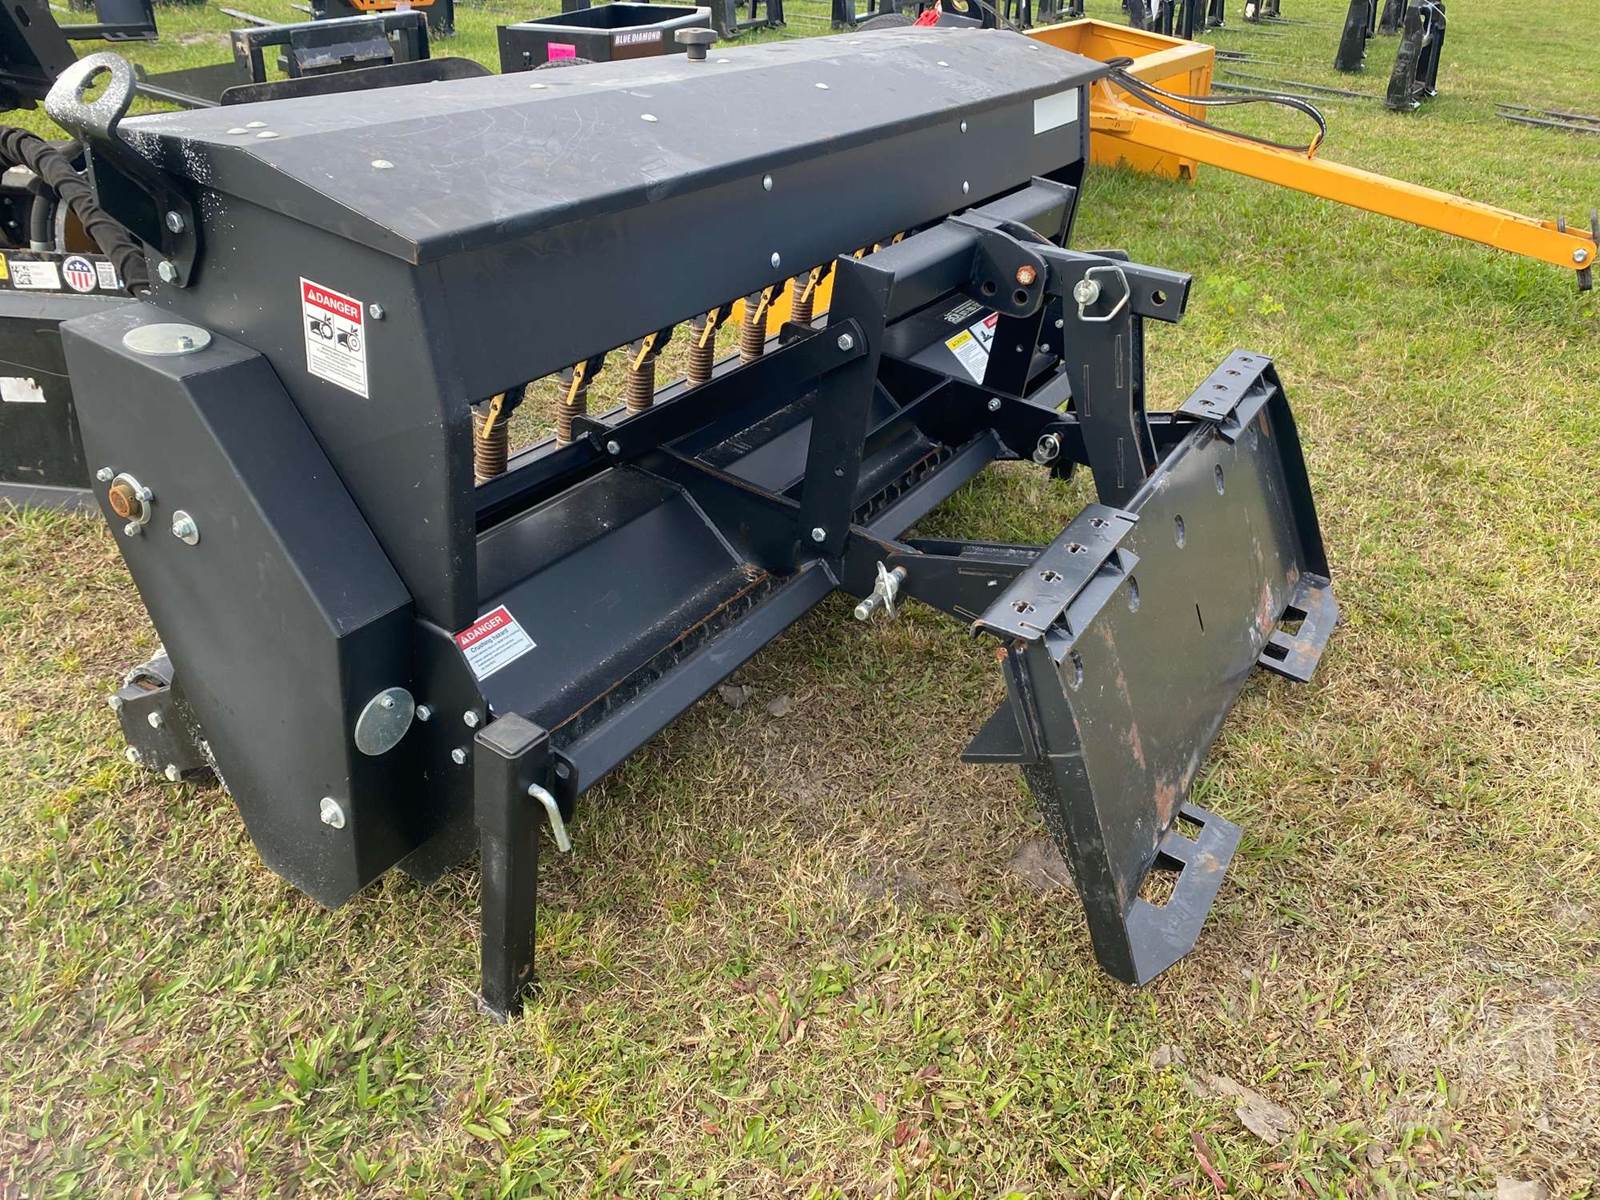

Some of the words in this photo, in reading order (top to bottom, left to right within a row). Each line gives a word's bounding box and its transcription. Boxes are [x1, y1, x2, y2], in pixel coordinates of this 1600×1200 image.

[615, 34, 631, 44] BLUE
[632, 31, 661, 42] DIAMOND
[316, 293, 358, 318] DANGER
[467, 616, 503, 640] DANGER
